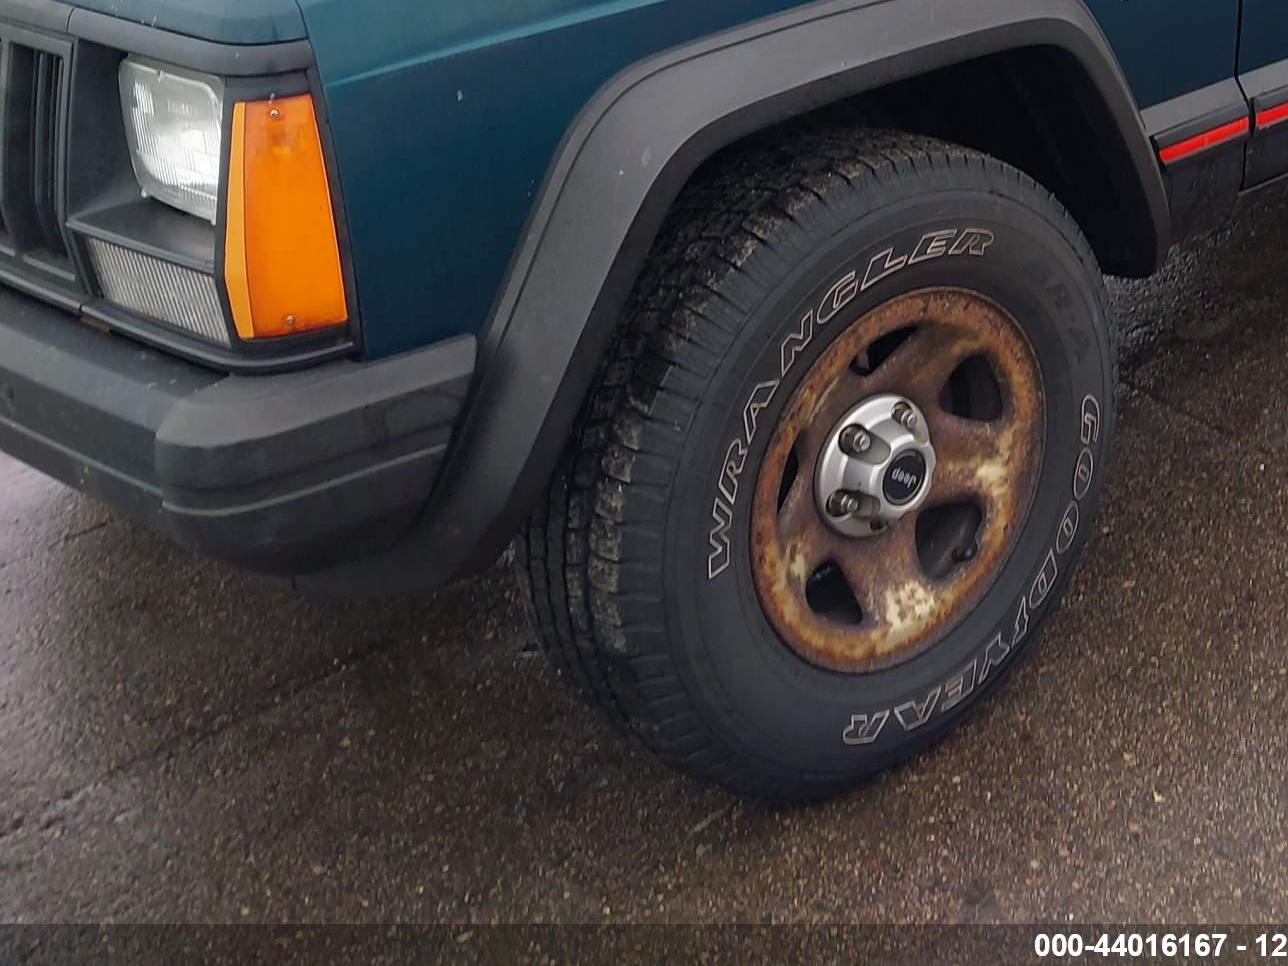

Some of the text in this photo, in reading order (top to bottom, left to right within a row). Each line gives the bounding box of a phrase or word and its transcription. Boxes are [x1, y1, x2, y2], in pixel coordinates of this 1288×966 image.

[708, 228, 994, 579] WRANGLER
[842, 394, 1101, 745] GOODYEAR
[891, 465, 918, 489] Jeep
